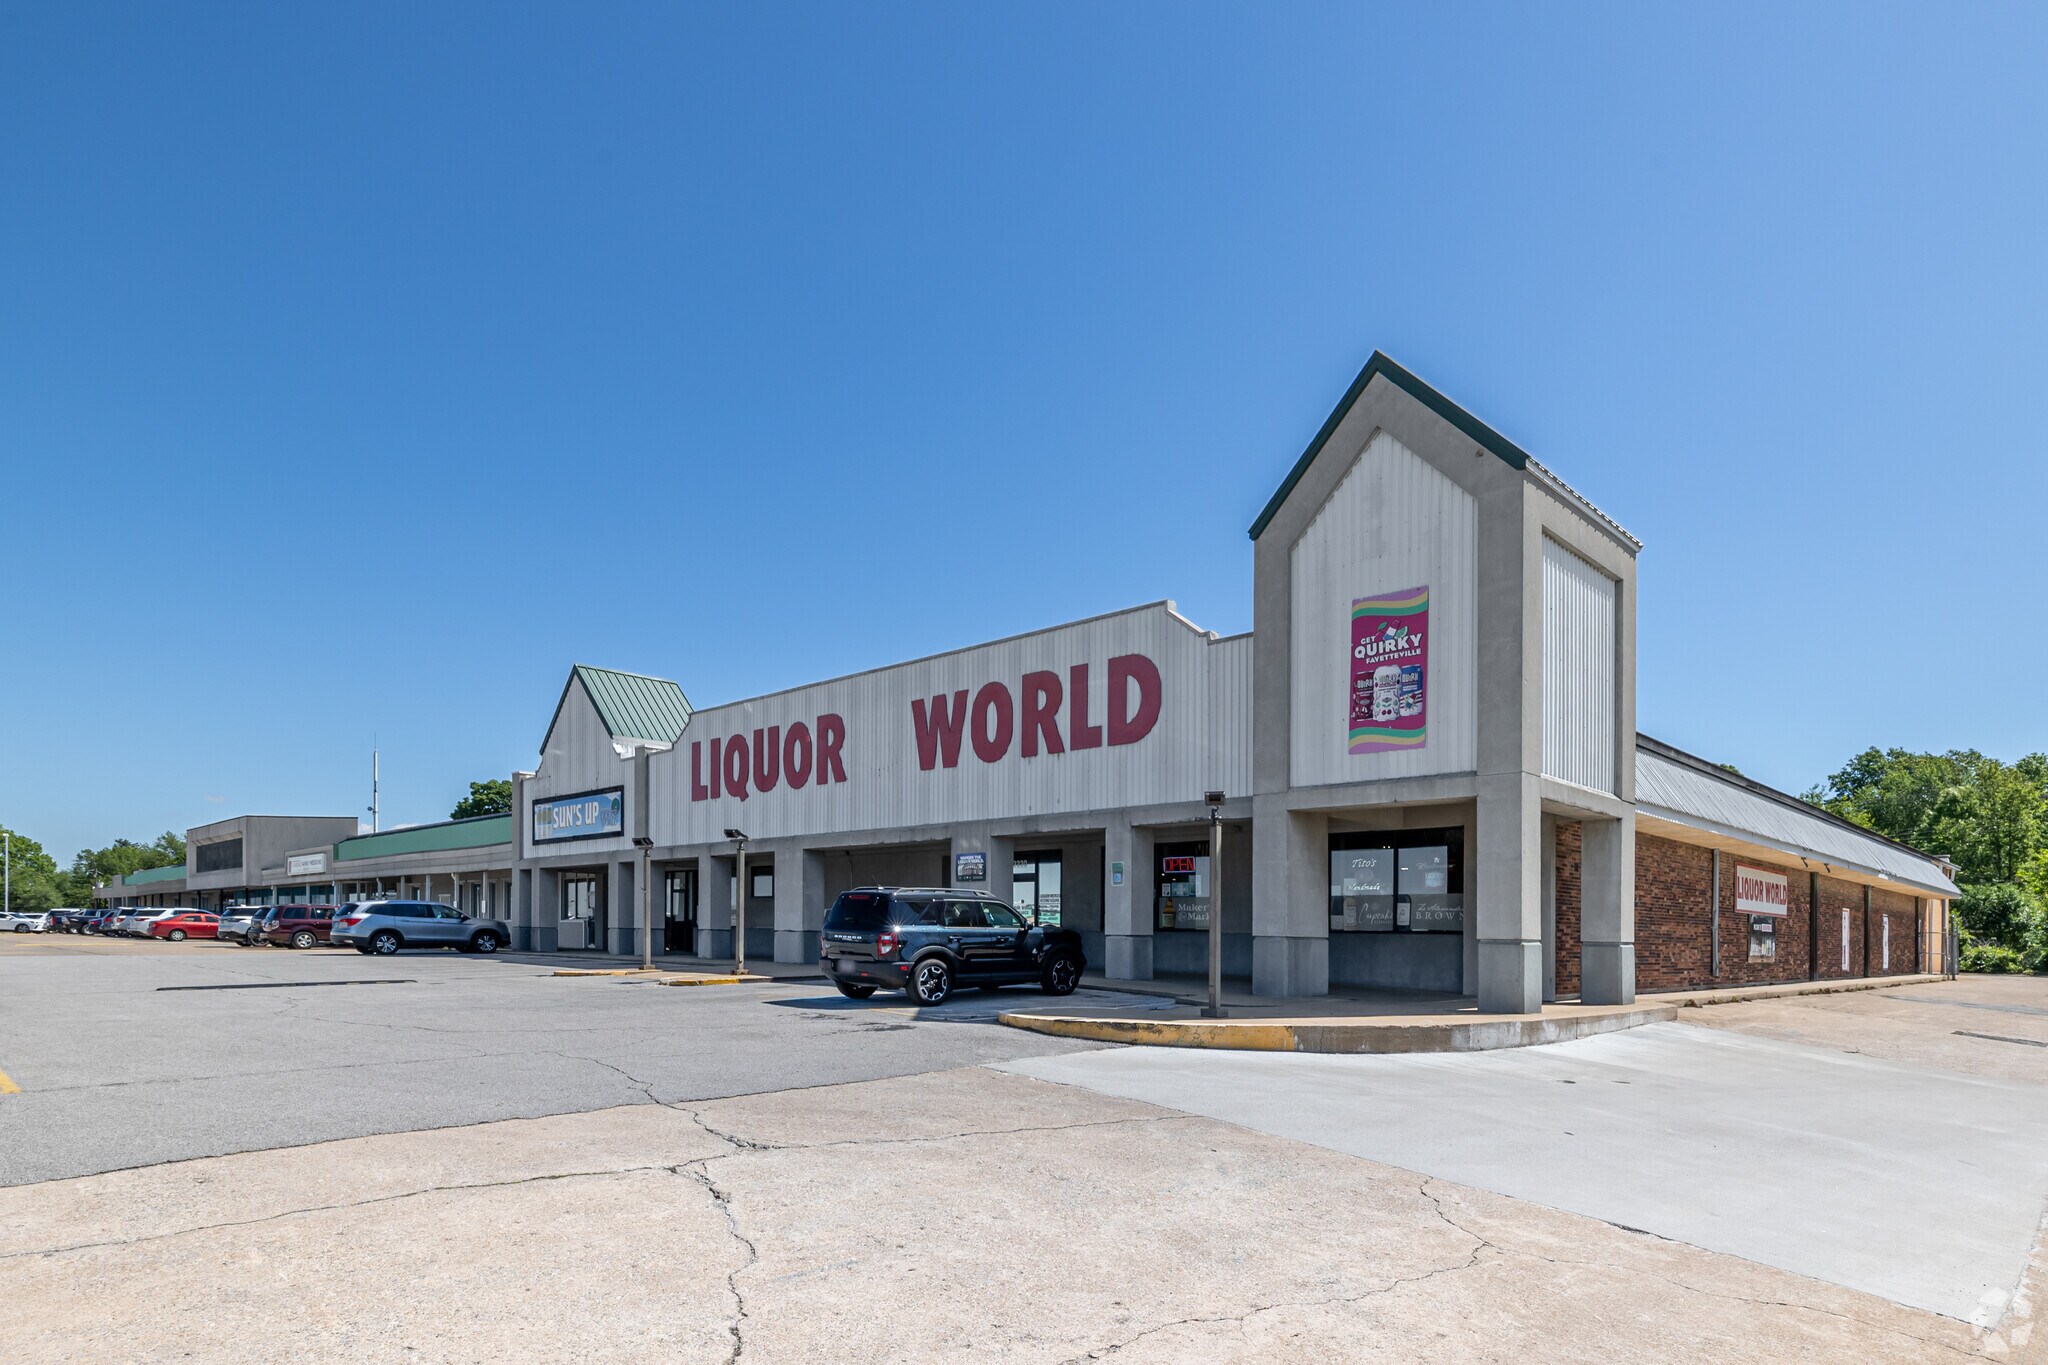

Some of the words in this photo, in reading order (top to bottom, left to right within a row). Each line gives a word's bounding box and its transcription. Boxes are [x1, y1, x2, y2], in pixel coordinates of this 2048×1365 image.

[1354, 633, 1423, 659] QUIRKY
[1361, 635, 1376, 645] GET
[1366, 648, 1421, 664] FAYETTEVILLE
[691, 713, 847, 802] LIQUOR
[911, 654, 1162, 772] WORLD
[553, 804, 583, 829] SUN'S
[585, 801, 600, 825] UP
[1164, 858, 1195, 871] OPEN
[1352, 858, 1377, 868] Tito's
[1737, 876, 1763, 902] LIQUOR
[1765, 881, 1786, 905] WORLD
[1178, 904, 1210, 912] Maker'
